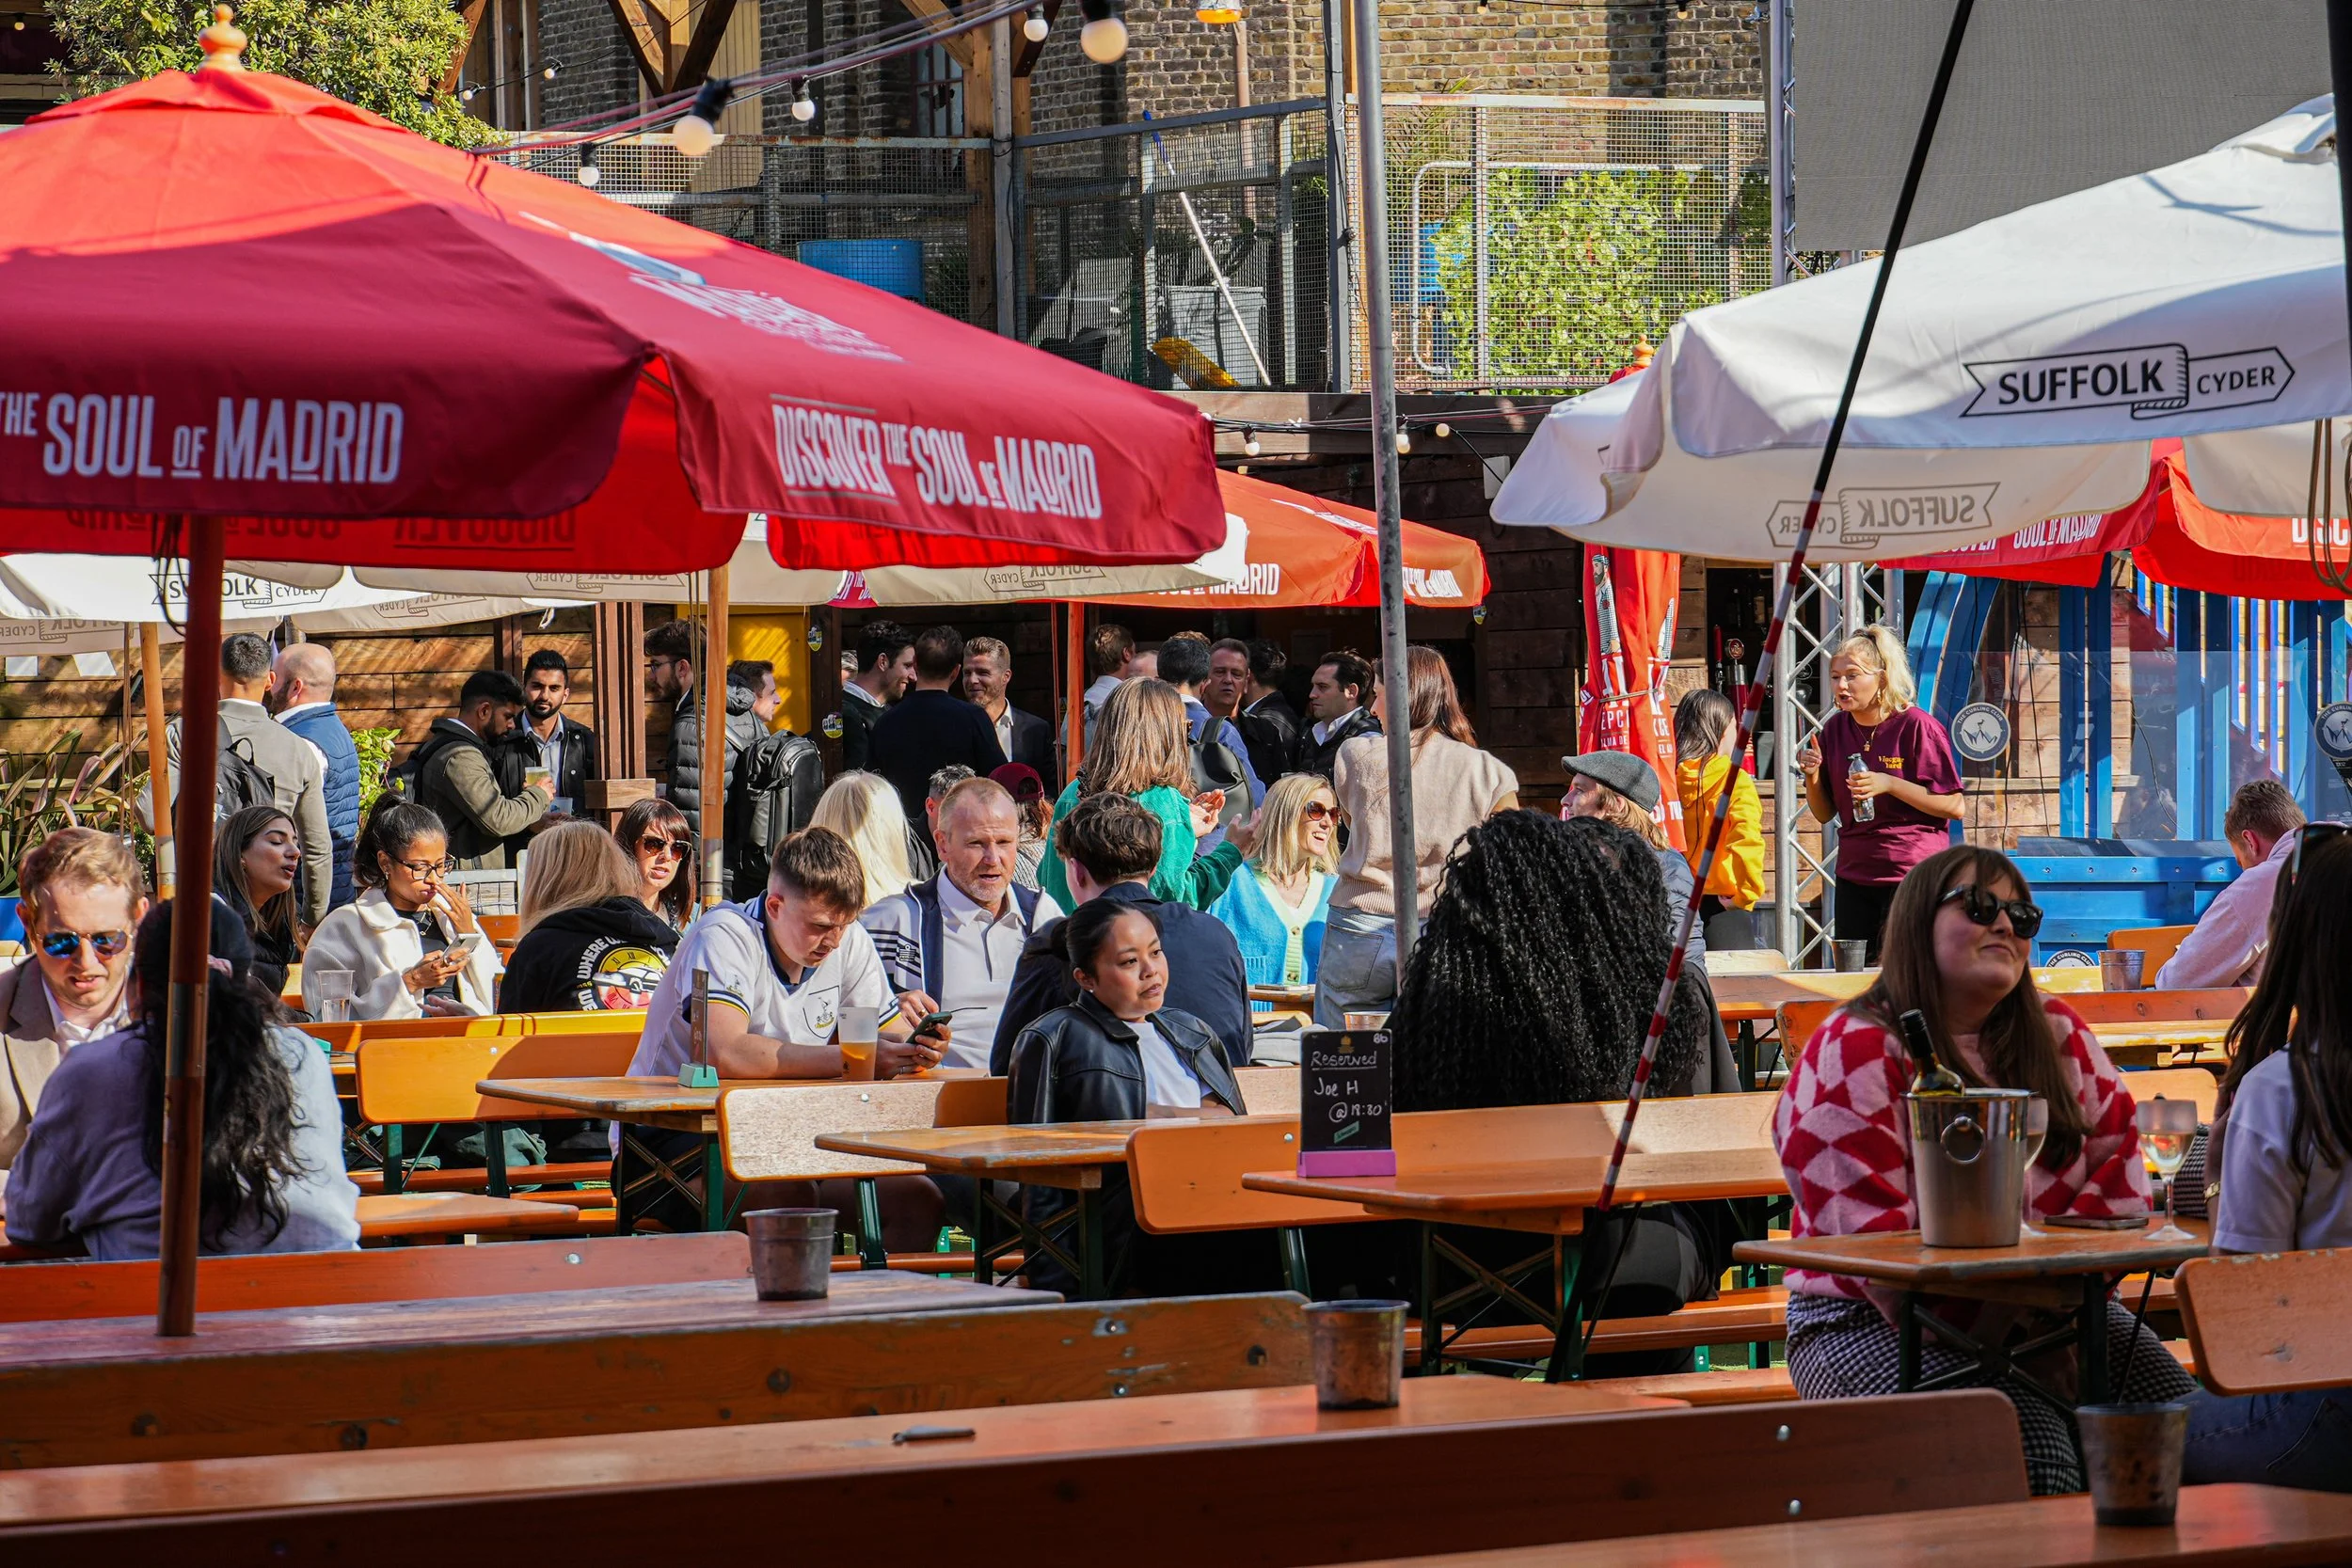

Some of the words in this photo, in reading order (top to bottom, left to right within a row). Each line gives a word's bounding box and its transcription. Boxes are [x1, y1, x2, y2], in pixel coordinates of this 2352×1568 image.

[1997, 359, 2166, 405] SUFFOLK
[2197, 366, 2276, 395] CYDER
[43, 393, 163, 478] SOUL
[171, 425, 208, 478] OF
[213, 396, 404, 483] MADRID
[771, 404, 897, 498] DISCOVER
[881, 421, 913, 467] THE
[910, 425, 988, 507] SOUL
[978, 460, 1007, 509] OF
[994, 436, 1103, 519] MADRID
[1957, 714, 1967, 724] THE
[1965, 706, 1990, 715] CURLING
[1990, 709, 2003, 721] CLUB
[577, 938, 610, 979] WHERE
[1311, 1051, 1377, 1067] Reserved
[1313, 1077, 1339, 1097] Joe
[1346, 1080, 1359, 1095] H
